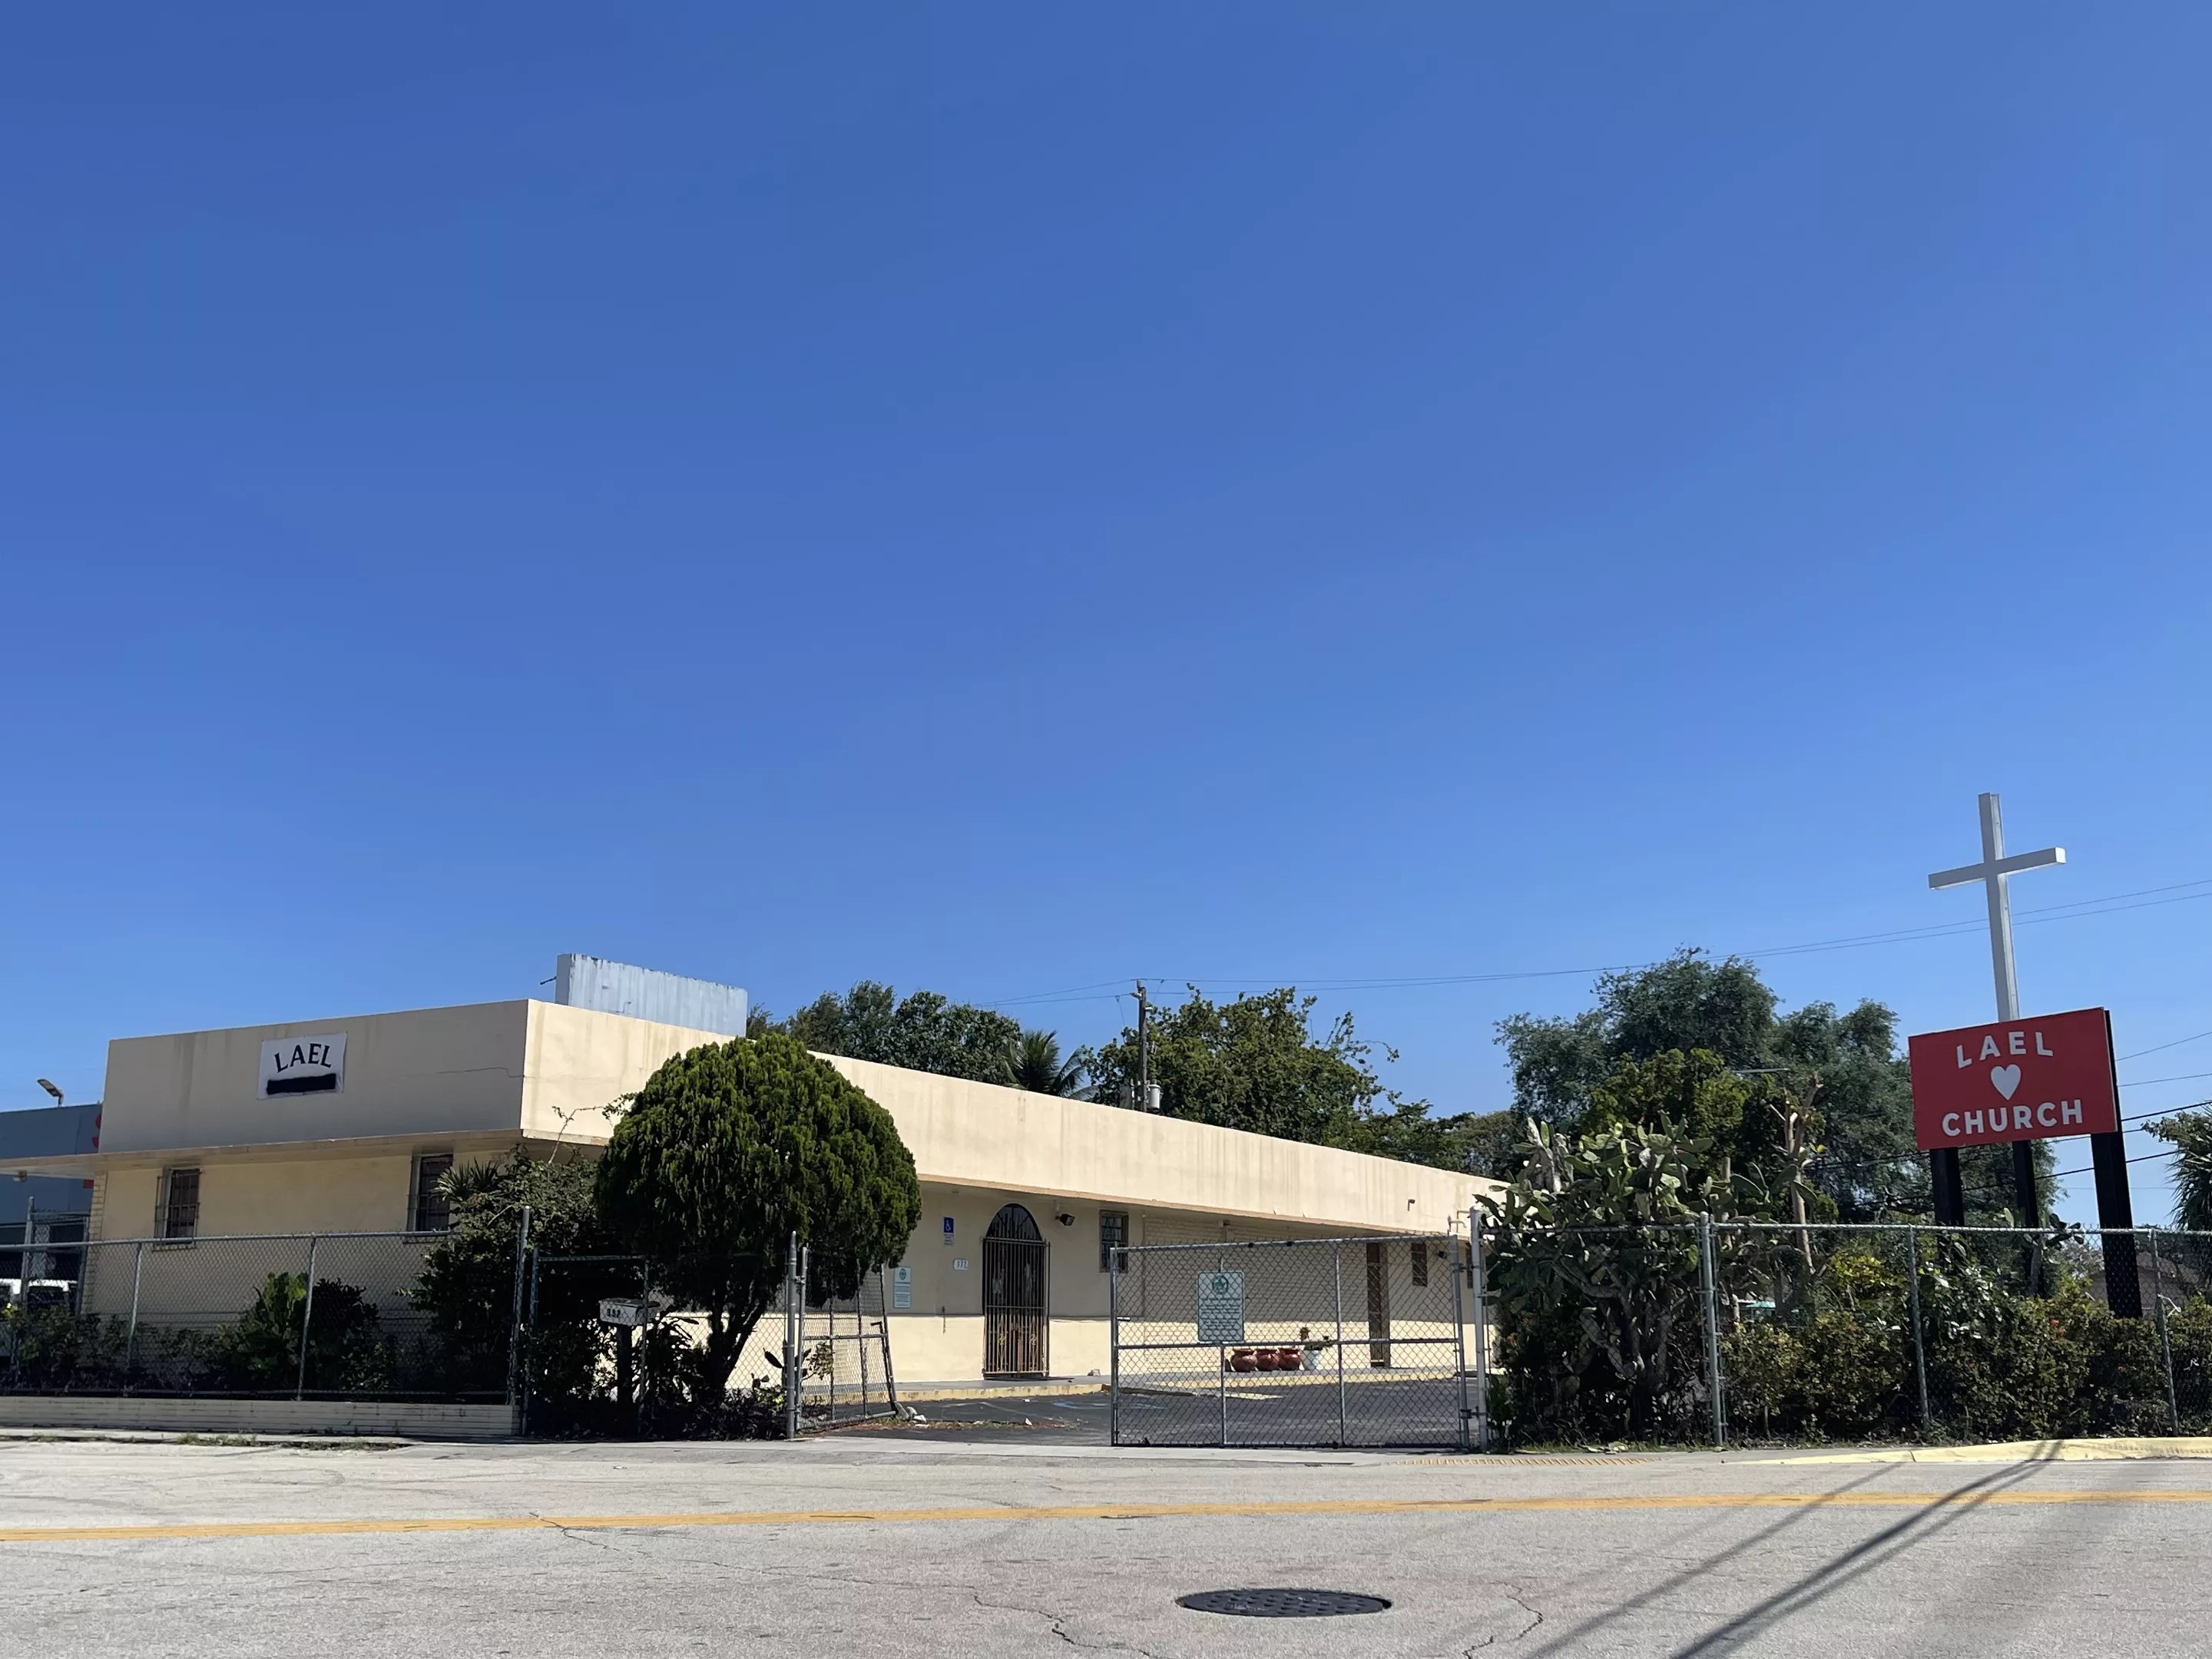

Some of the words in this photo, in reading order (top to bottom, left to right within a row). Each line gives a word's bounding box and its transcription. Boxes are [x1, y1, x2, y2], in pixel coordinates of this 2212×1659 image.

[273, 1042, 332, 1074] LAEL
[1956, 1031, 2054, 1069] LAEL
[1942, 1099, 2083, 1137] CHURCH
